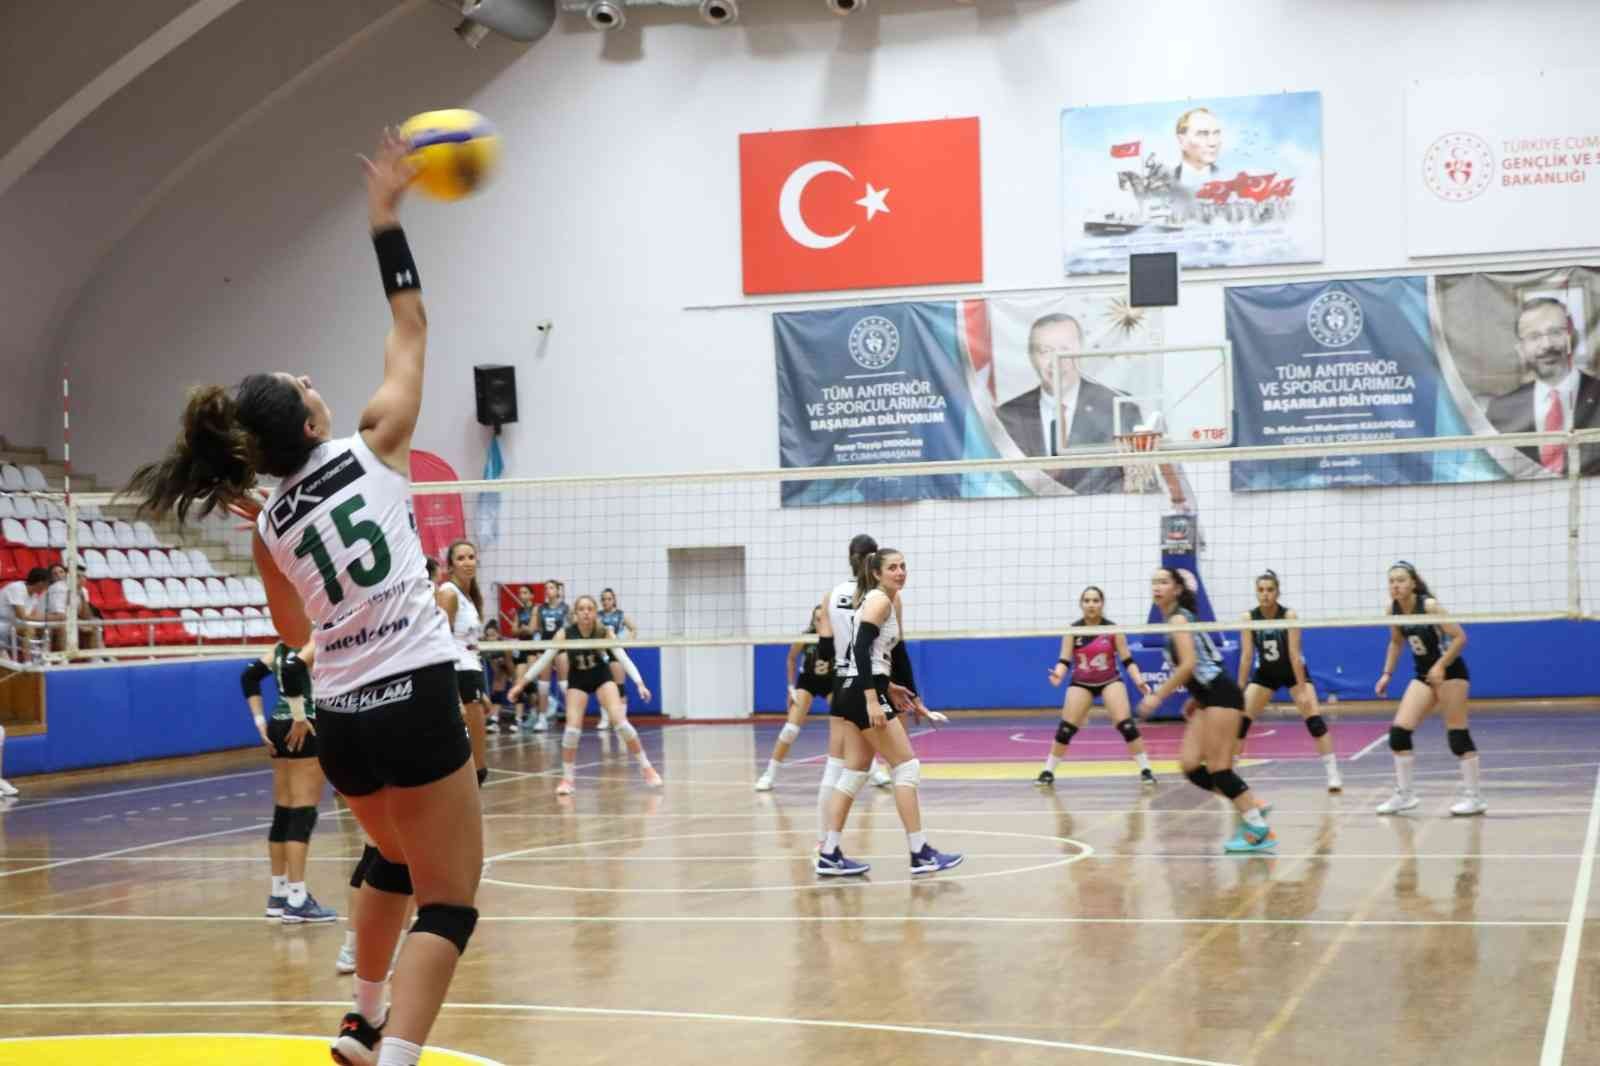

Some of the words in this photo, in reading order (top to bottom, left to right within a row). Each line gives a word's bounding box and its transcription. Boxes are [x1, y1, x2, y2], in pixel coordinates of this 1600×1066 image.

[1572, 153, 1592, 166] VE
[1502, 169, 1585, 187] BAKANLIĞI
[1276, 363, 1312, 381] TÜM
[1315, 359, 1398, 378] ANTRENÖR
[821, 384, 854, 401] TÜM
[856, 379, 931, 399] ANTRENÖR
[1259, 381, 1280, 397] VE
[1282, 375, 1416, 395] SPORCULARIMIZA
[805, 403, 825, 417] VE
[827, 395, 947, 416] SPORCULARIMIZA
[1263, 395, 1337, 413] BAŞARILAR
[1338, 392, 1414, 408] DİLİYORUM
[810, 415, 876, 432] BAŞARILAR
[294, 493, 392, 606] 15
[1262, 639, 1281, 661] 3
[1077, 652, 1109, 671] 14
